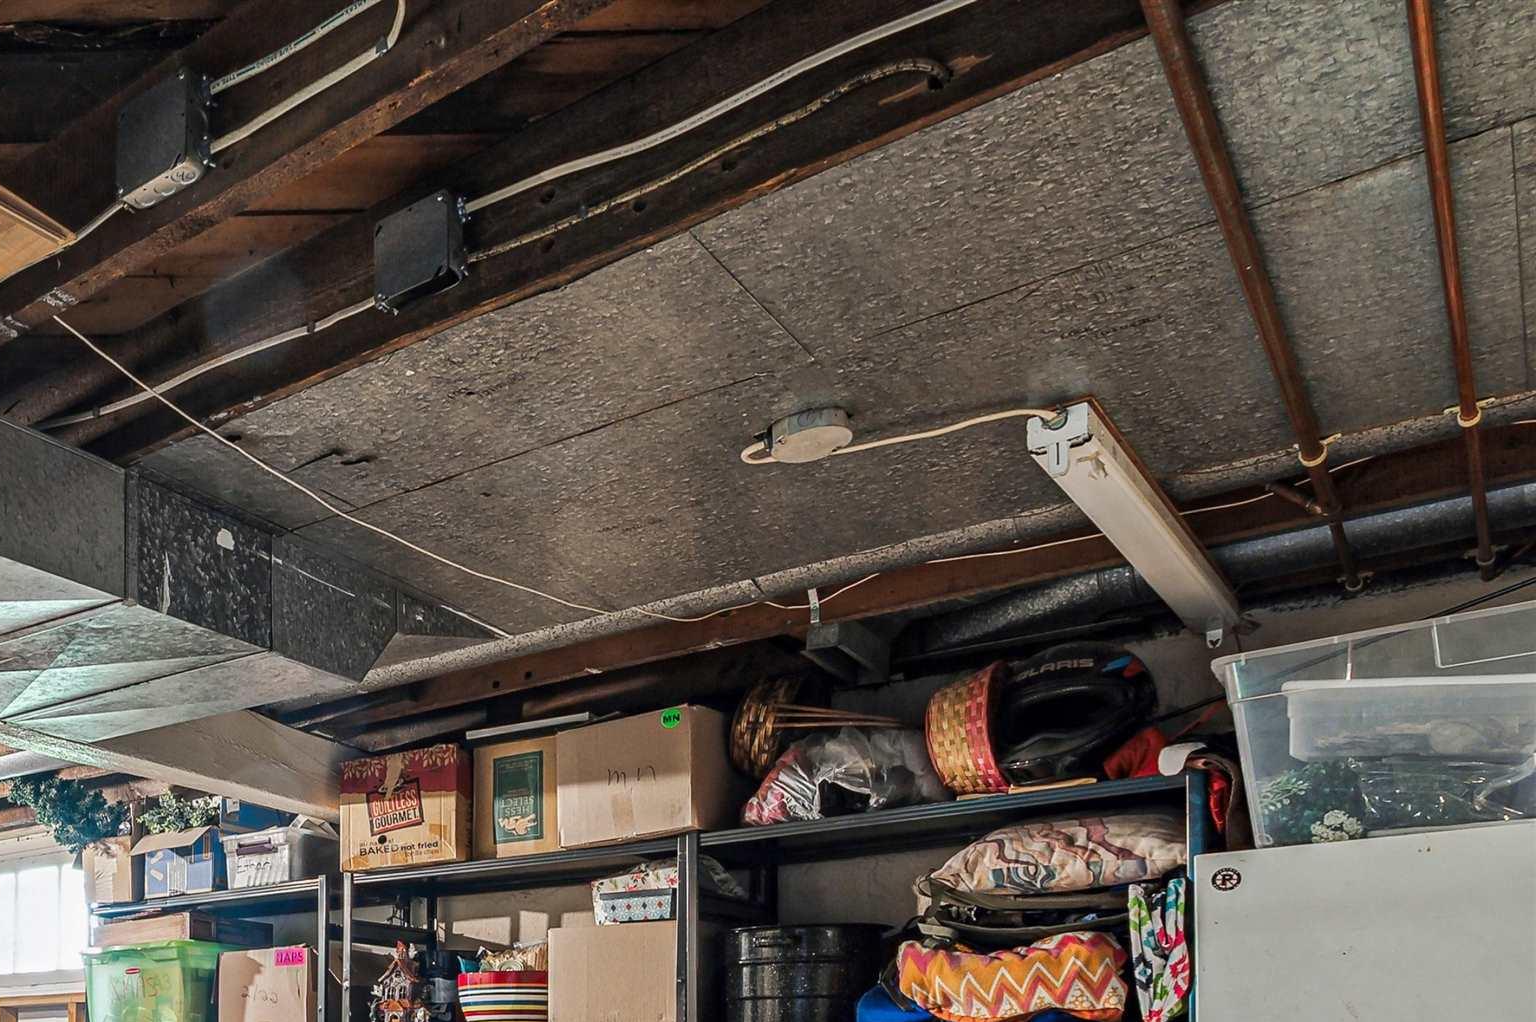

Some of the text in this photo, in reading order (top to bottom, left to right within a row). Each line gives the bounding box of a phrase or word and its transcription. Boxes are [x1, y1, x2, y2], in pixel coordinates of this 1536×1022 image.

[1015, 658, 1095, 682] OLARIS
[663, 713, 680, 724] MN
[372, 789, 418, 817] GUILTLESS
[500, 795, 535, 808] SELECT
[505, 804, 533, 816] HESS
[359, 844, 400, 857] BAKED
[400, 843, 416, 851] not
[417, 840, 439, 849] fried
